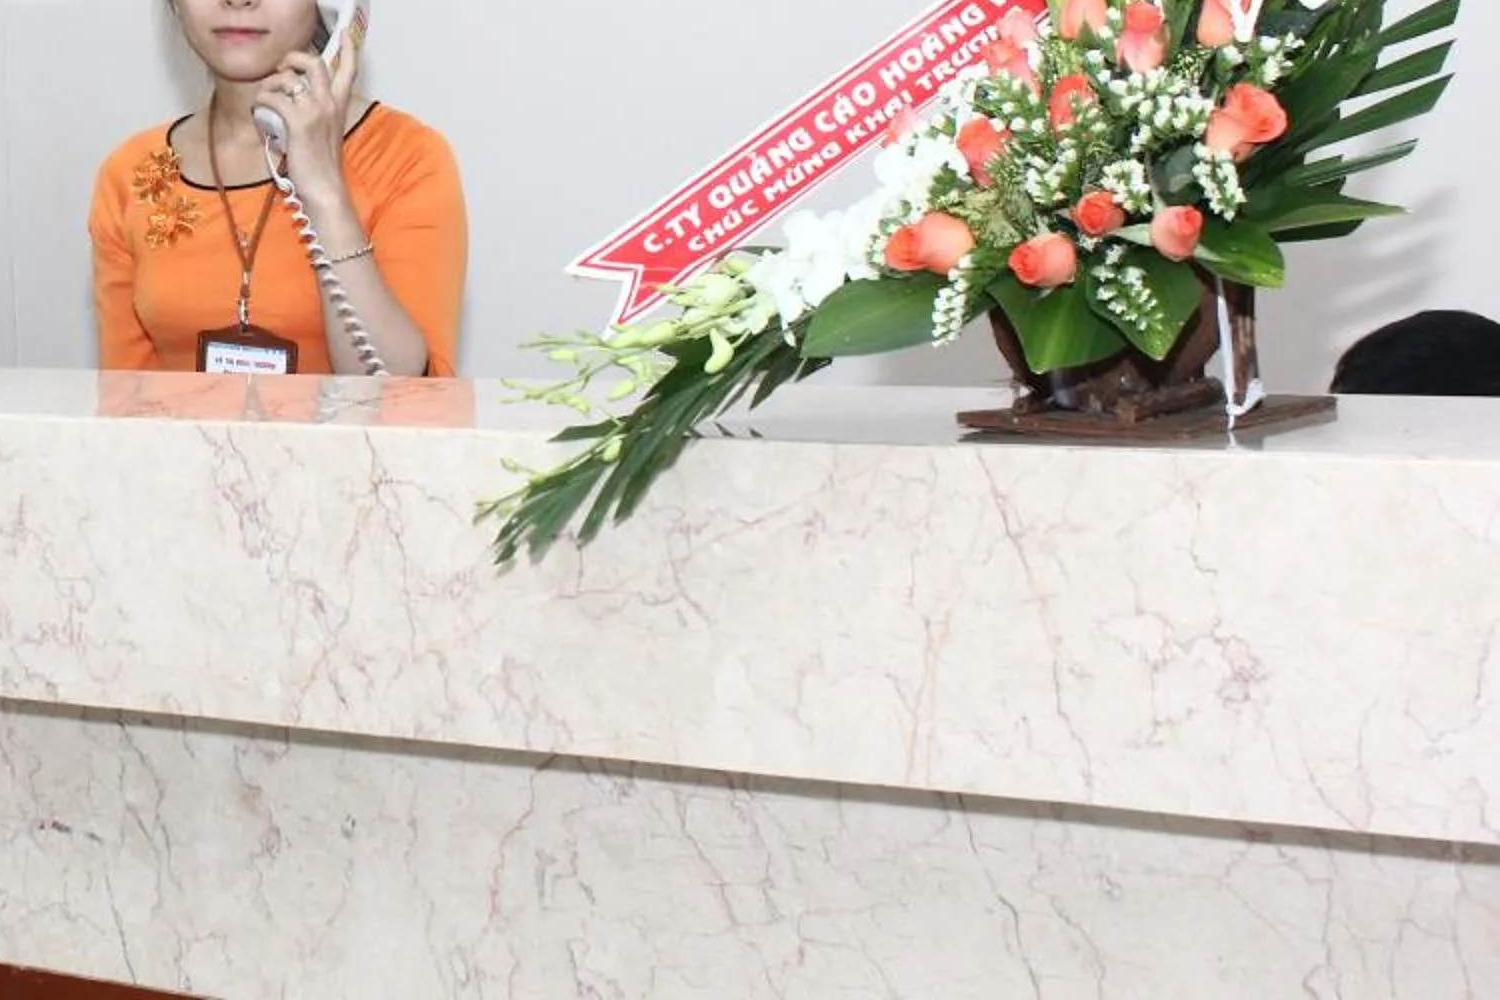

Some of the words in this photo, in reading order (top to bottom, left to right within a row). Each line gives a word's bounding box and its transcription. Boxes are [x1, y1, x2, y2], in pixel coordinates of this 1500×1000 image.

[643, 199, 702, 255] C.TY
[707, 124, 813, 207] QUẢNG
[880, 3, 986, 88] HOÀNG
[687, 199, 759, 252] CHÚC
[763, 138, 840, 203] MỪNG
[848, 89, 914, 142] KHAI
